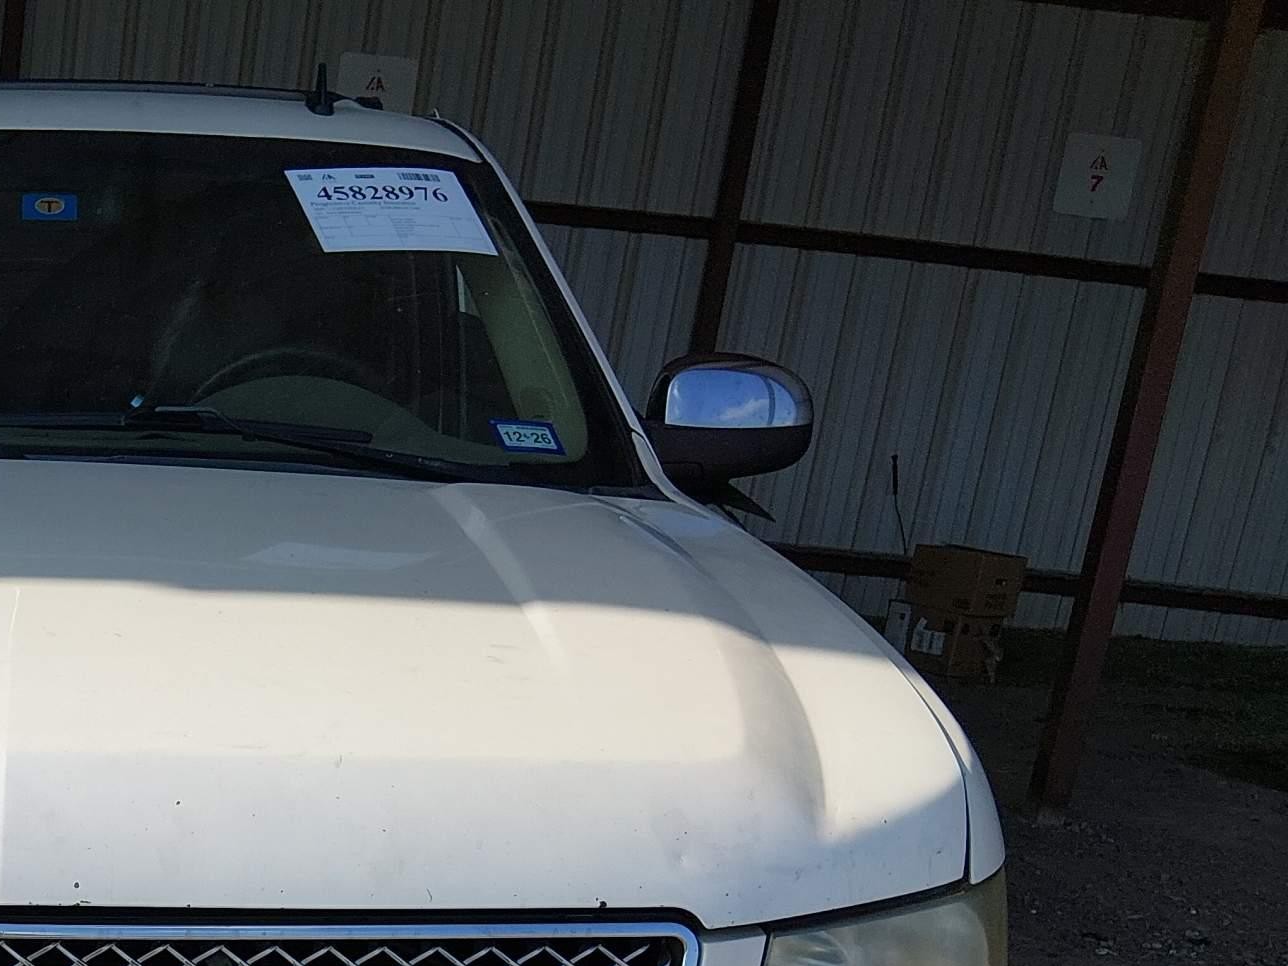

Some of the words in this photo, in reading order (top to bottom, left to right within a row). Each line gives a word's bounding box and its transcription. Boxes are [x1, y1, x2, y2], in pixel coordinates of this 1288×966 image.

[1090, 174, 1104, 192] 7
[316, 185, 449, 203] 45828976
[39, 199, 59, 213] T
